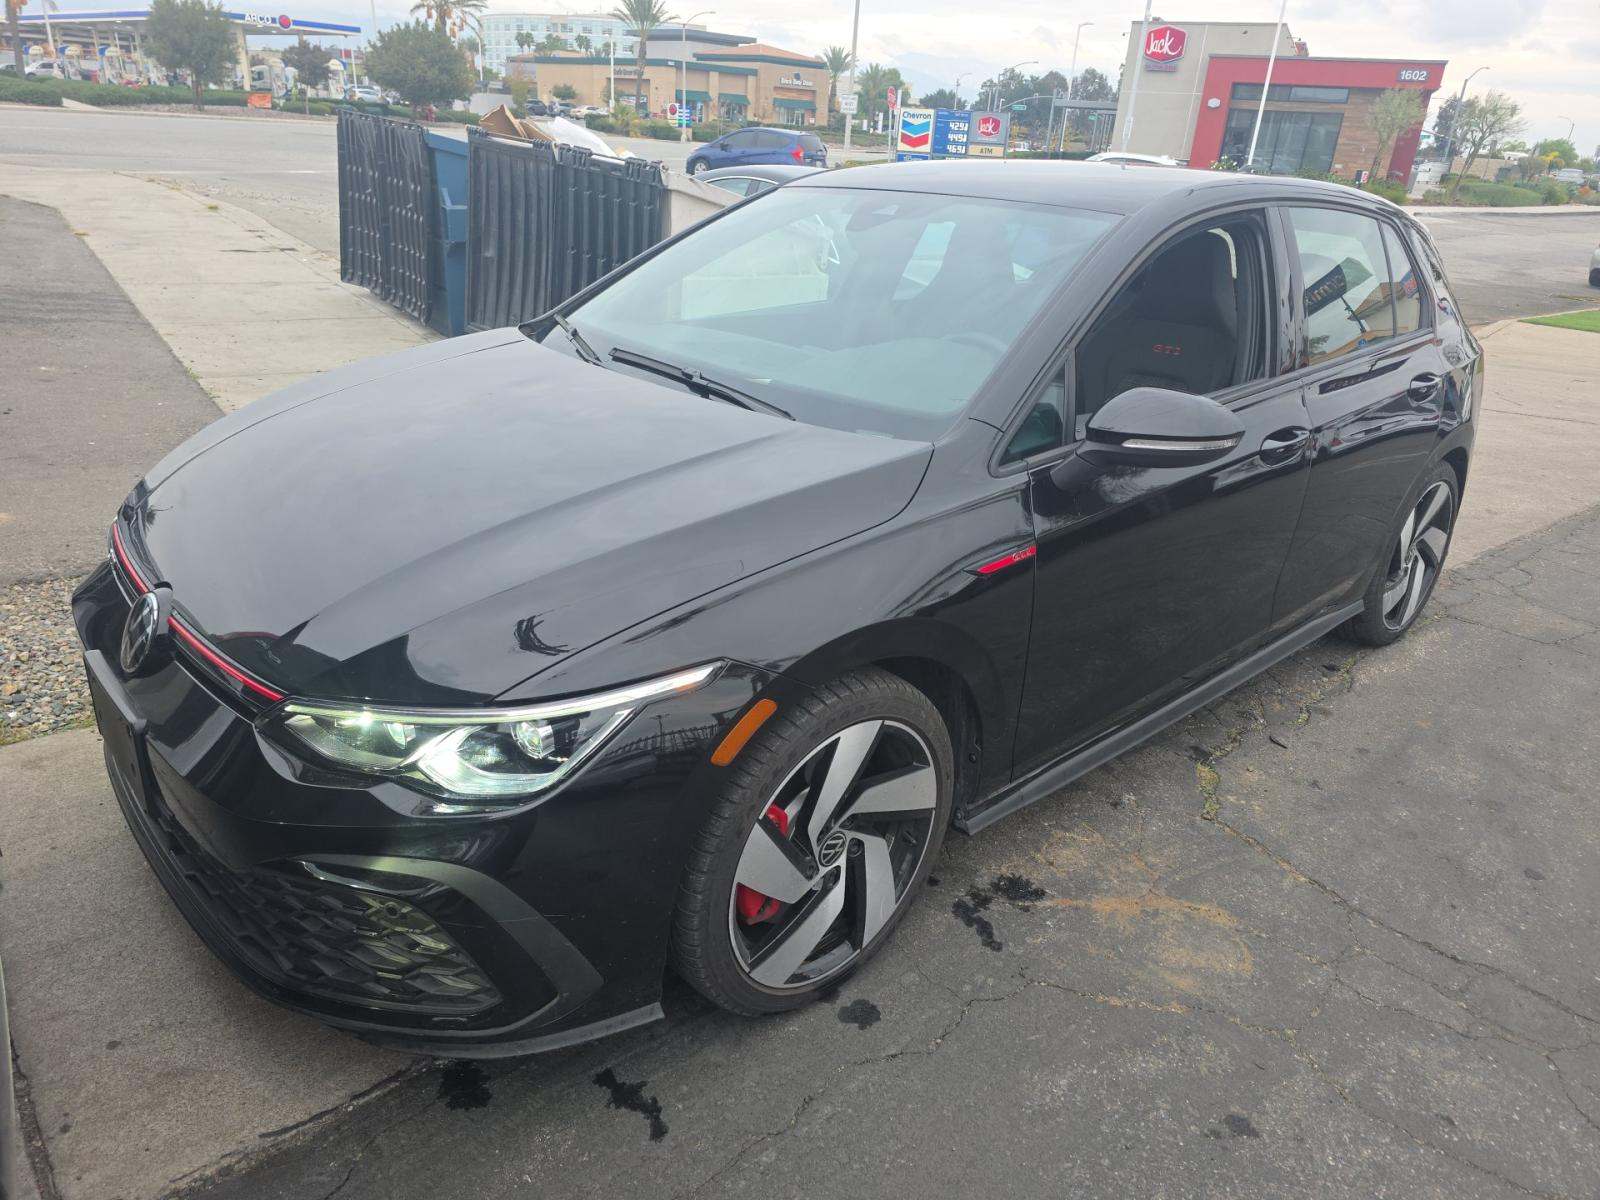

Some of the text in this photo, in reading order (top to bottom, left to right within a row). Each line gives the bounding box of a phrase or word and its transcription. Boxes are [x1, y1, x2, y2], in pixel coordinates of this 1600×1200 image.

[244, 13, 272, 24] ARCO
[1146, 29, 1182, 55] Jack
[1400, 70, 1427, 81] 1602
[902, 111, 932, 119] Chevron
[979, 147, 993, 155] ATM
